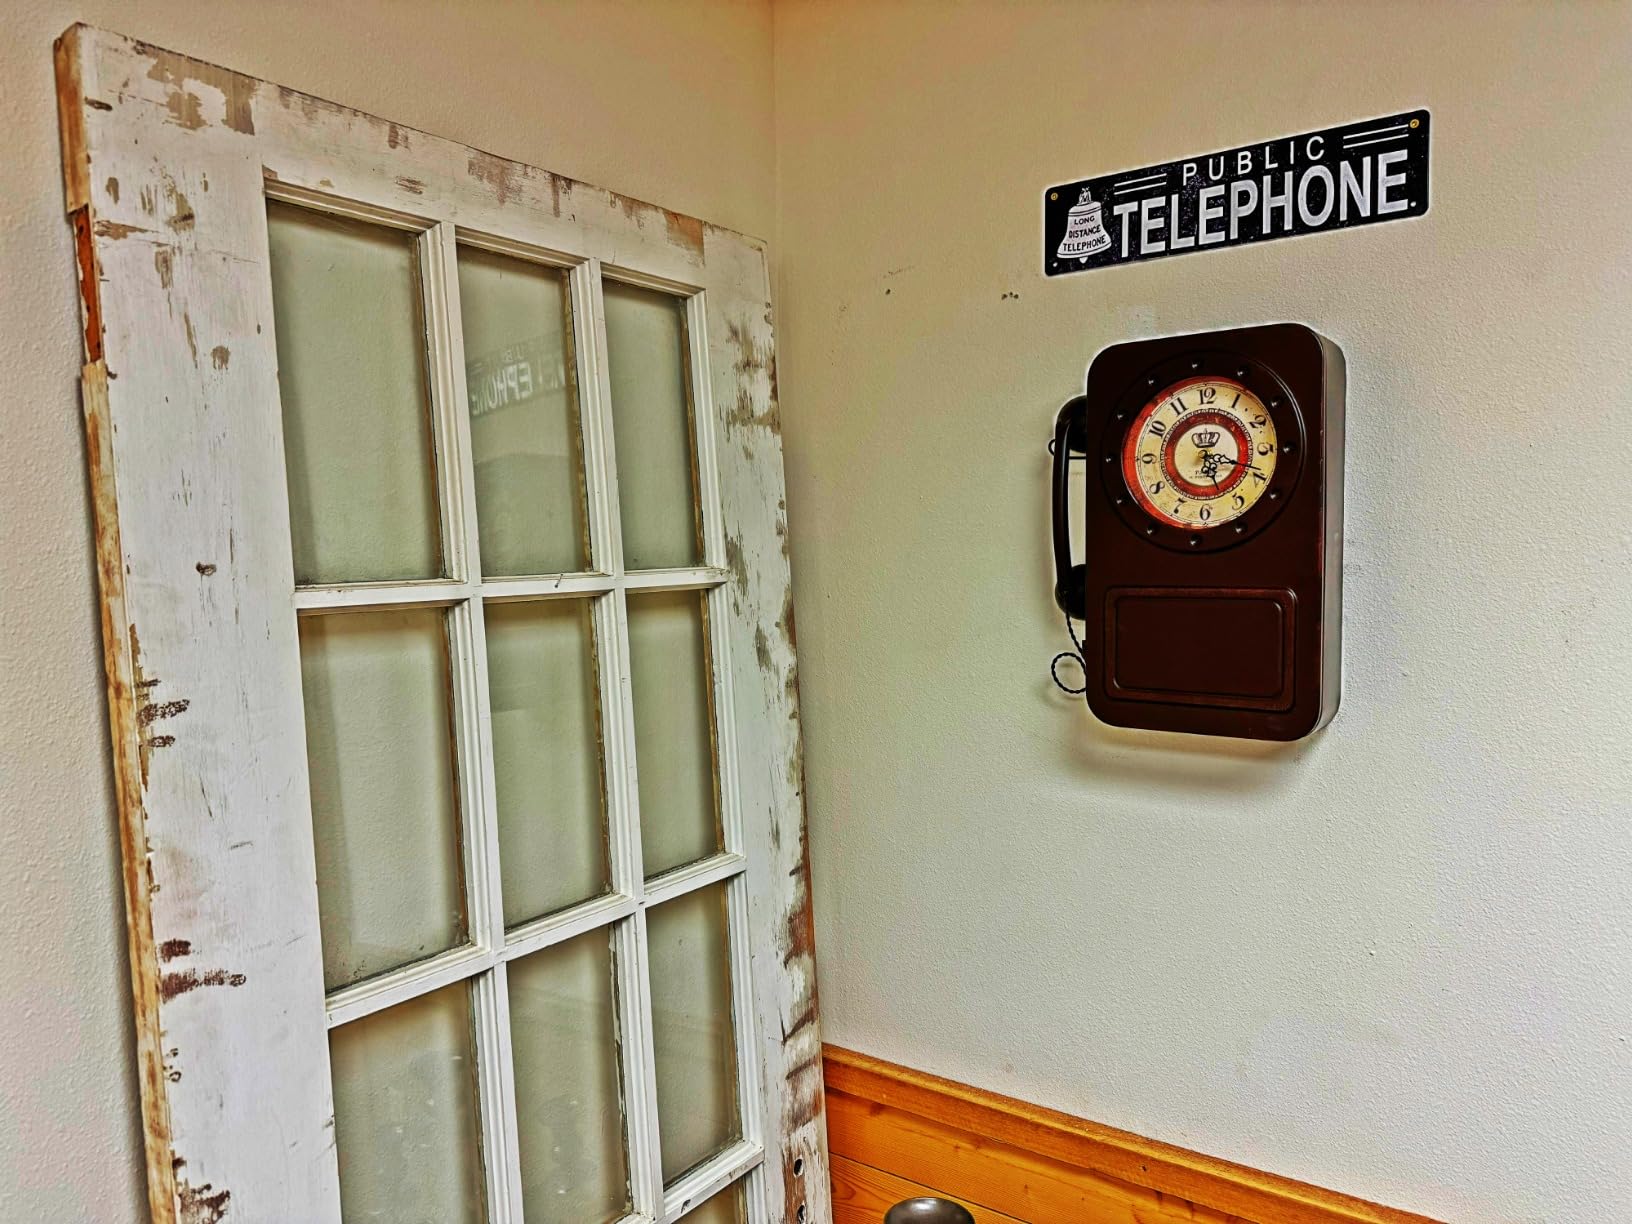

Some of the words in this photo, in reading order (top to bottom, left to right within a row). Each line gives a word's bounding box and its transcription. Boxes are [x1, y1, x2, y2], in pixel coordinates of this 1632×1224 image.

[1182, 135, 1326, 186] PUBLIC
[1113, 149, 1409, 258] TELEPHONE
[1074, 215, 1095, 225] LONG
[1068, 224, 1101, 239] DISTANCE
[1063, 234, 1106, 252] TELEPHONE
[1197, 387, 1217, 406] 12
[1230, 393, 1241, 410] 1
[1170, 397, 1189, 416] 11
[1149, 420, 1167, 438] 10
[1249, 414, 1267, 431] 2
[1257, 442, 1273, 457] 3
[1141, 453, 1157, 465] 9
[1149, 481, 1166, 495] 8
[1251, 471, 1268, 488] 4
[1173, 497, 1187, 514] 7
[1231, 492, 1245, 511] 5
[1199, 504, 1211, 521] 6
